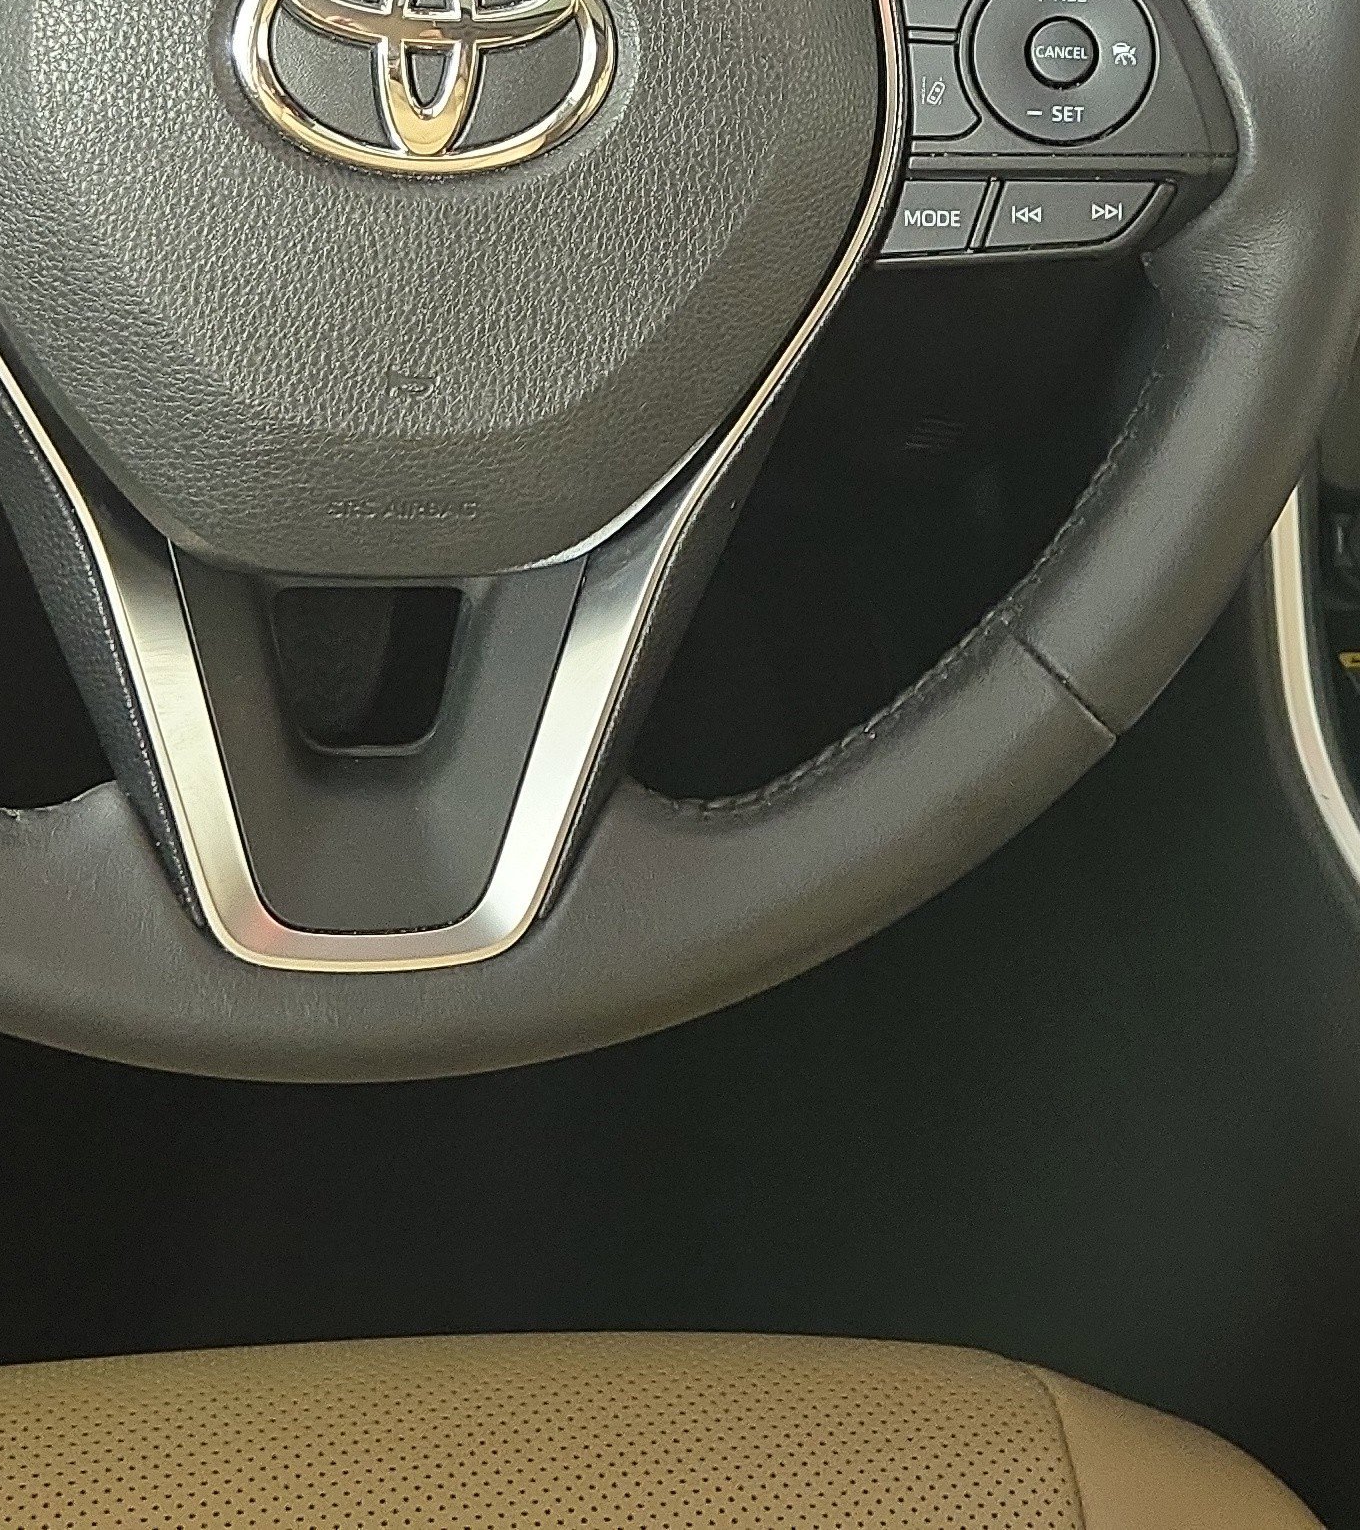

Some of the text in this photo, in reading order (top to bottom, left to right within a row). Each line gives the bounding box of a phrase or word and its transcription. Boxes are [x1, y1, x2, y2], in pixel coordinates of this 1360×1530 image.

[1035, 45, 1088, 60] CANCEL
[1051, 106, 1085, 122] SET
[903, 210, 961, 228] MODE
